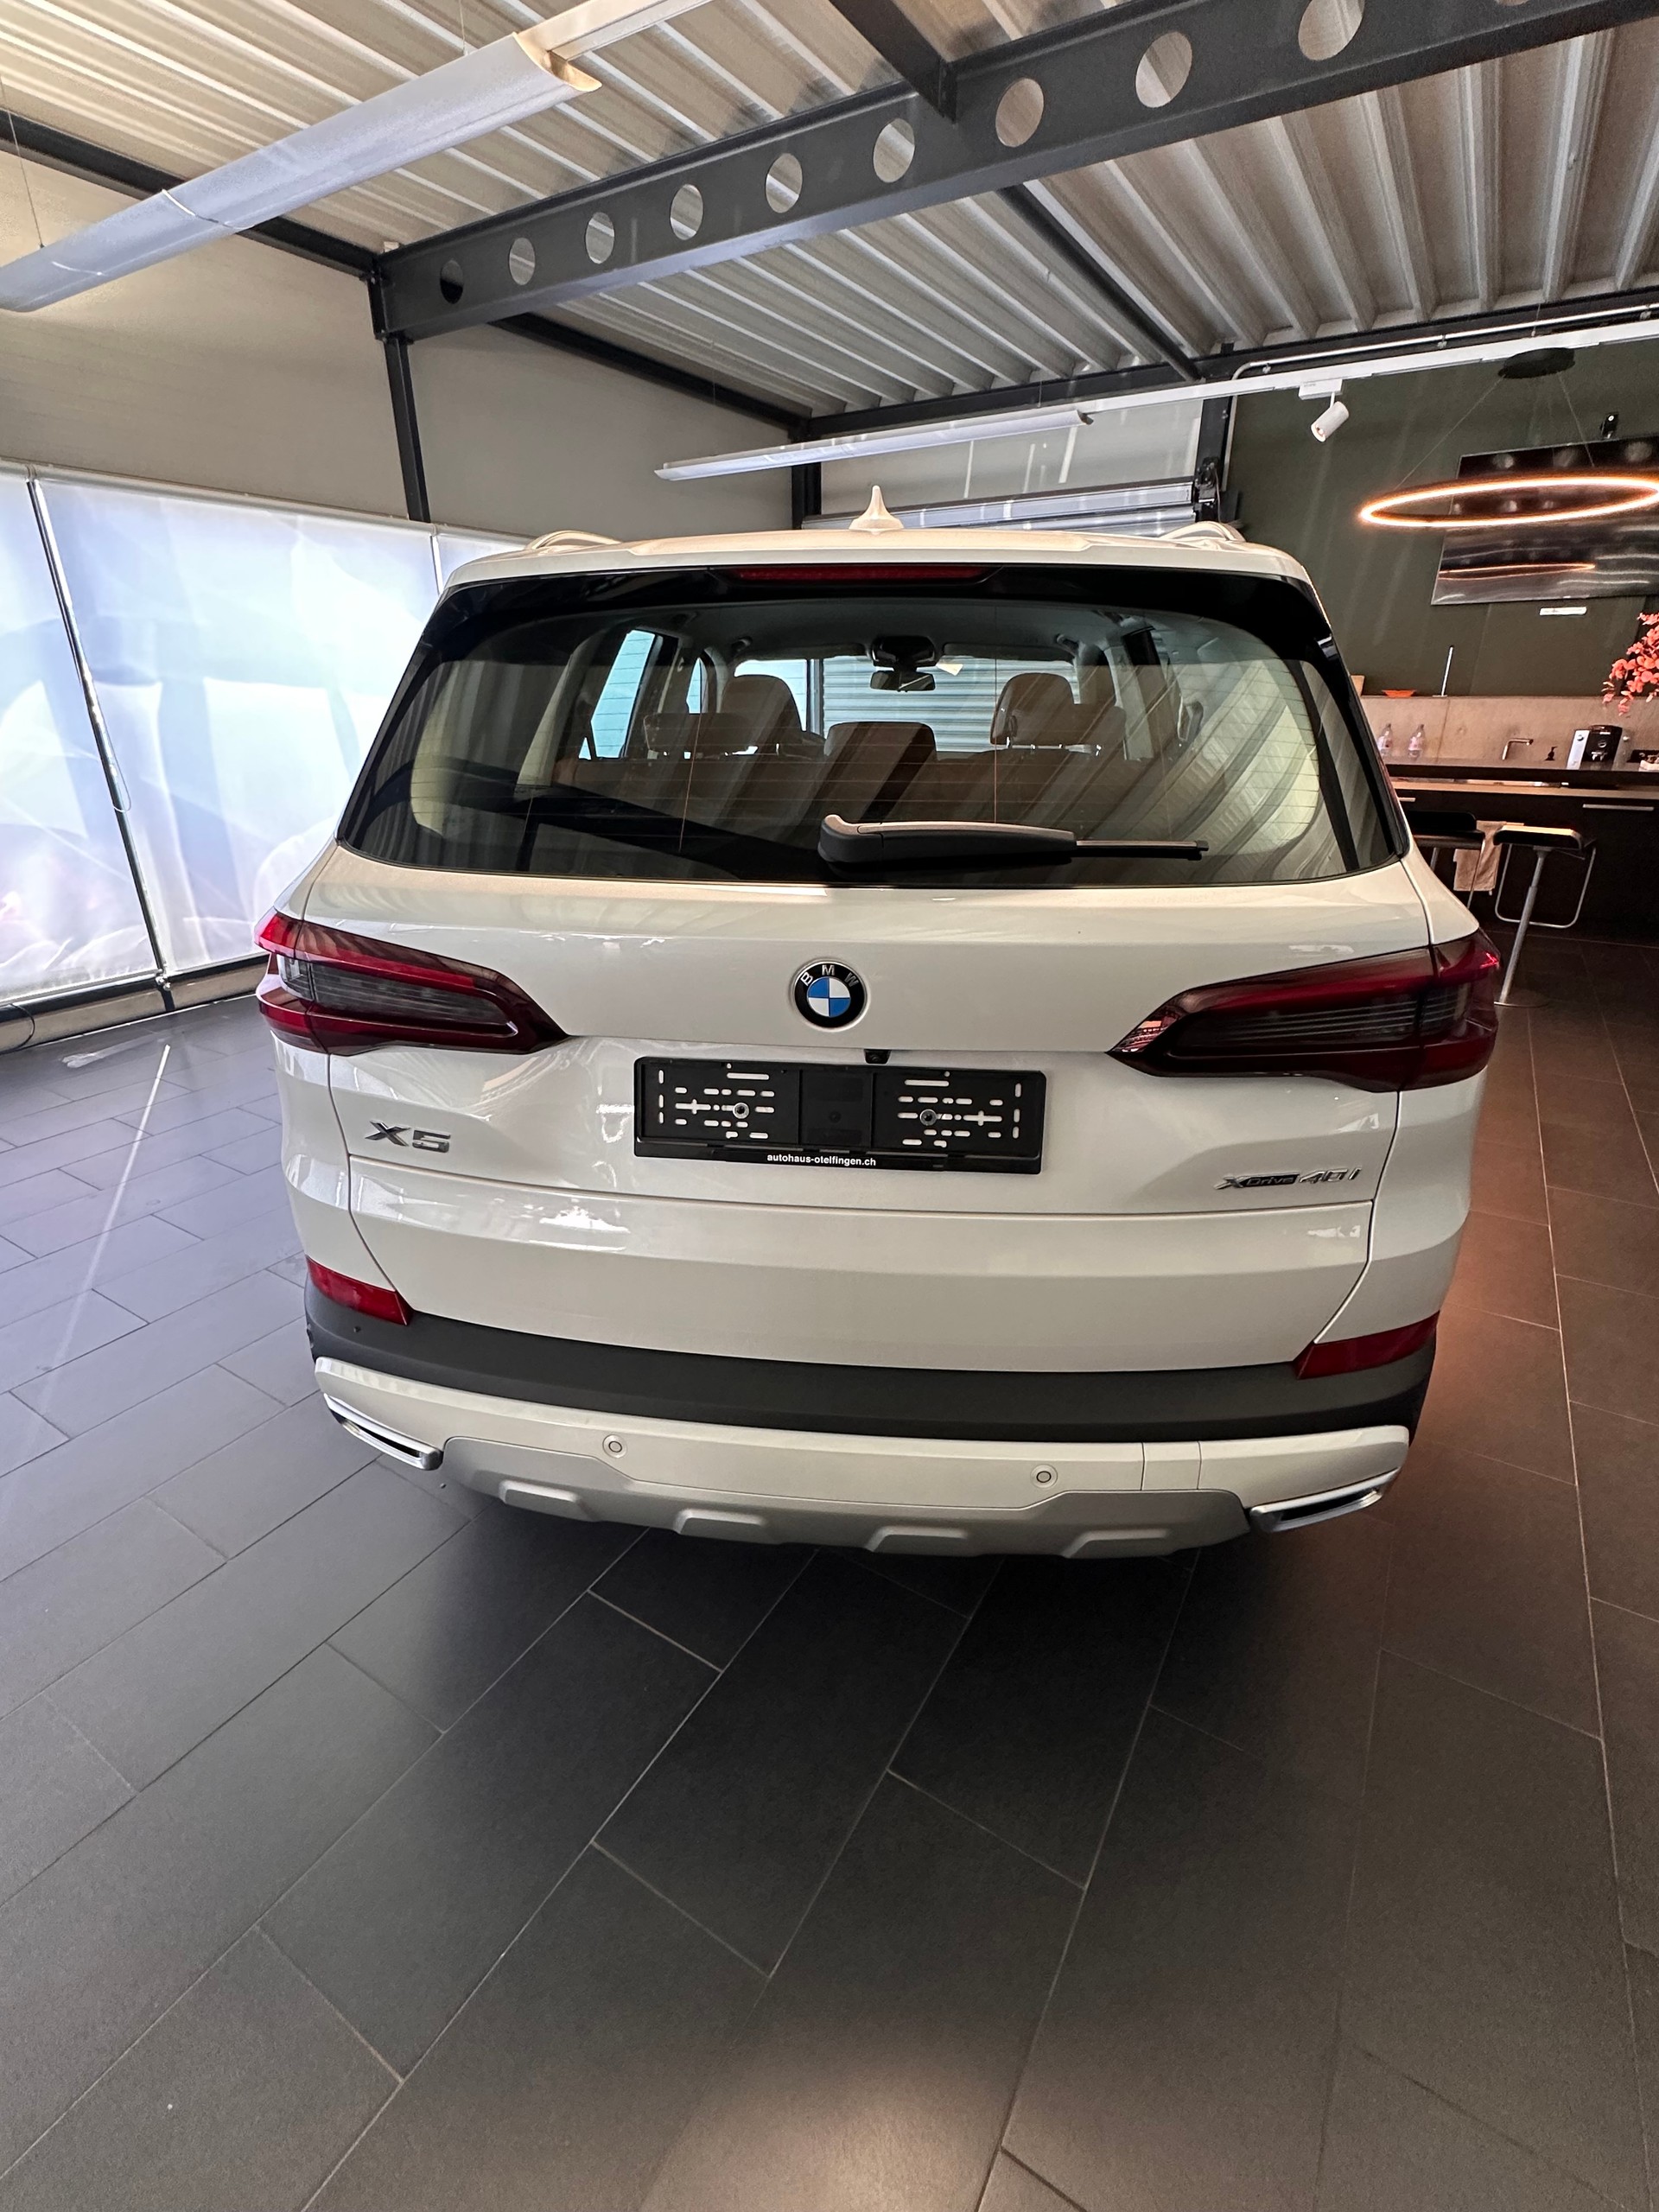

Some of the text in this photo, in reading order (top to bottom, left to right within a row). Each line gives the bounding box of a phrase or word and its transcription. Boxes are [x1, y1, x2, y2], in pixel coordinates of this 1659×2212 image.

[800, 964, 860, 987] BMW
[365, 1121, 451, 1153] X5
[766, 1154, 876, 1166] autohaus-otelfingen.ch
